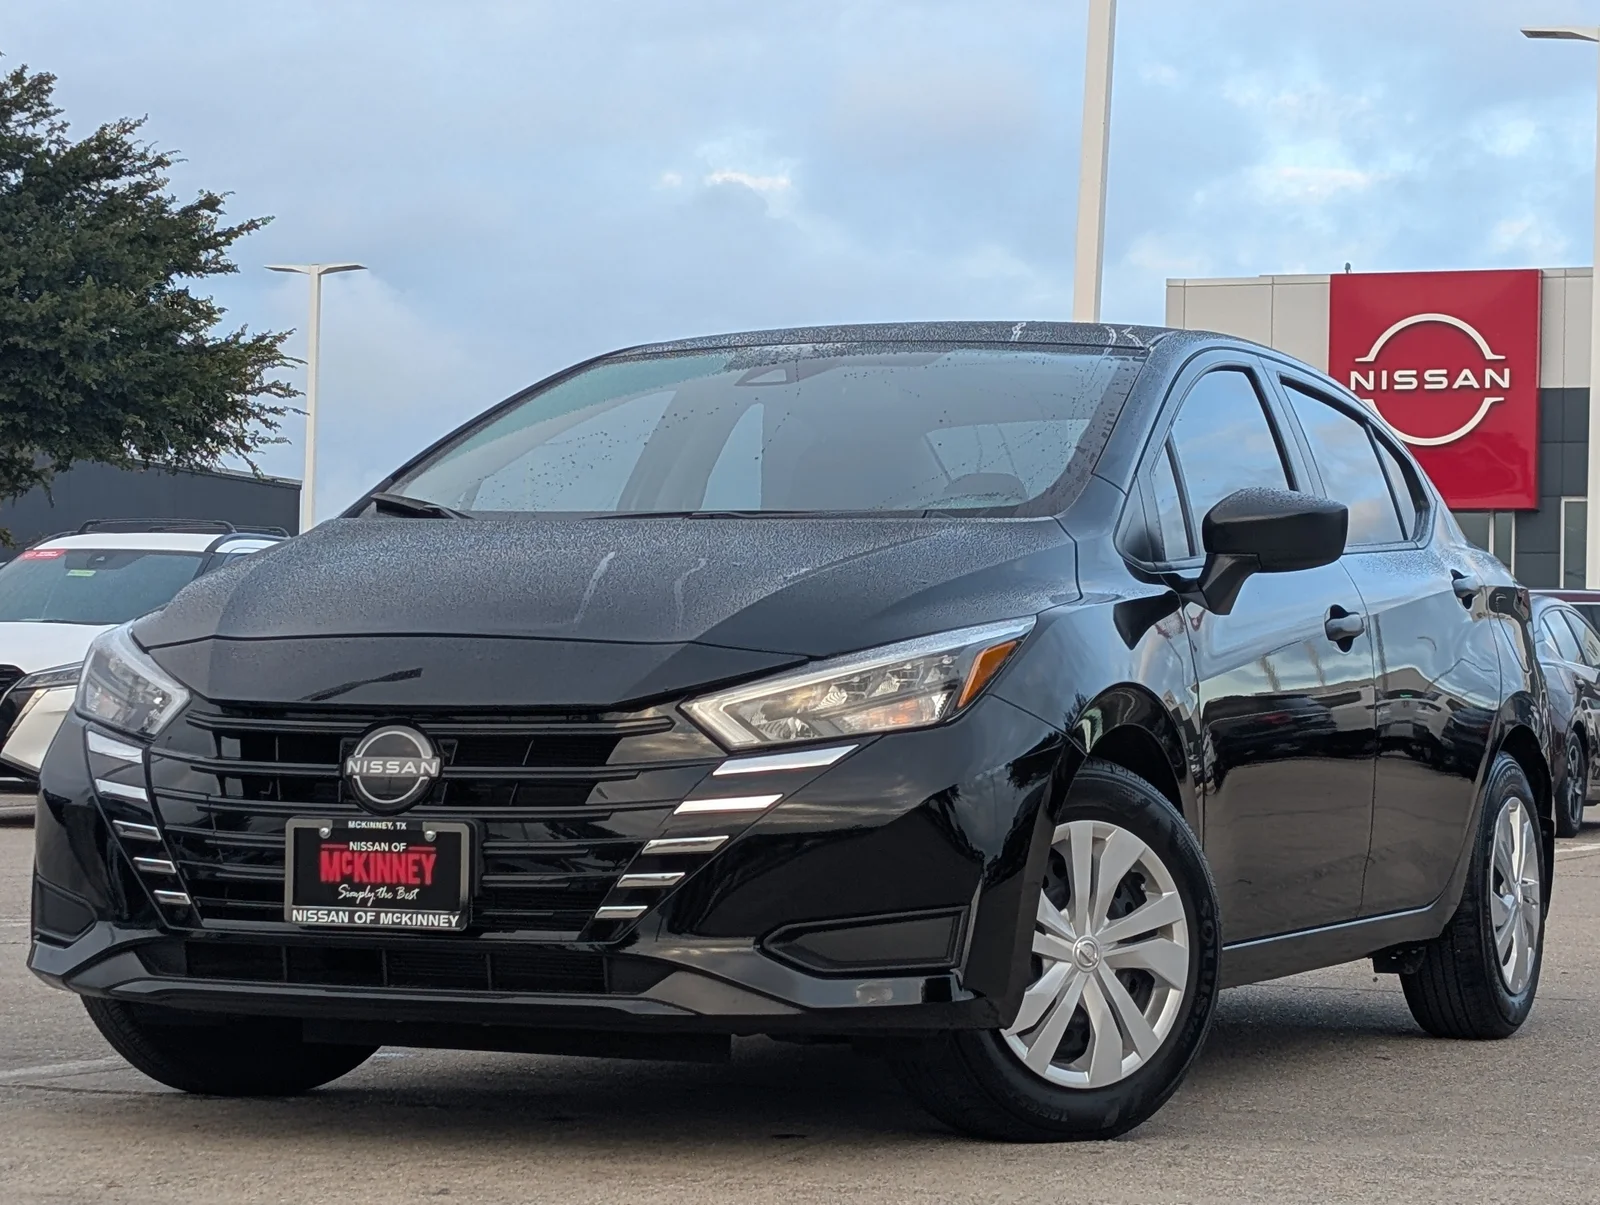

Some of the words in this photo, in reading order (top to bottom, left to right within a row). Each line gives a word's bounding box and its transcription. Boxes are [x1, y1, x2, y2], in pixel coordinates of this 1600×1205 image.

[1350, 368, 1510, 391] NISSAN
[347, 760, 437, 775] NISSAN
[395, 821, 407, 831] TX
[349, 841, 389, 852] NISSAN
[391, 842, 407, 853] OF
[337, 884, 375, 906] Simply
[375, 886, 393, 900] the
[396, 886, 420, 900] Best
[292, 909, 349, 923] NISSAN
[354, 911, 376, 925] OF
